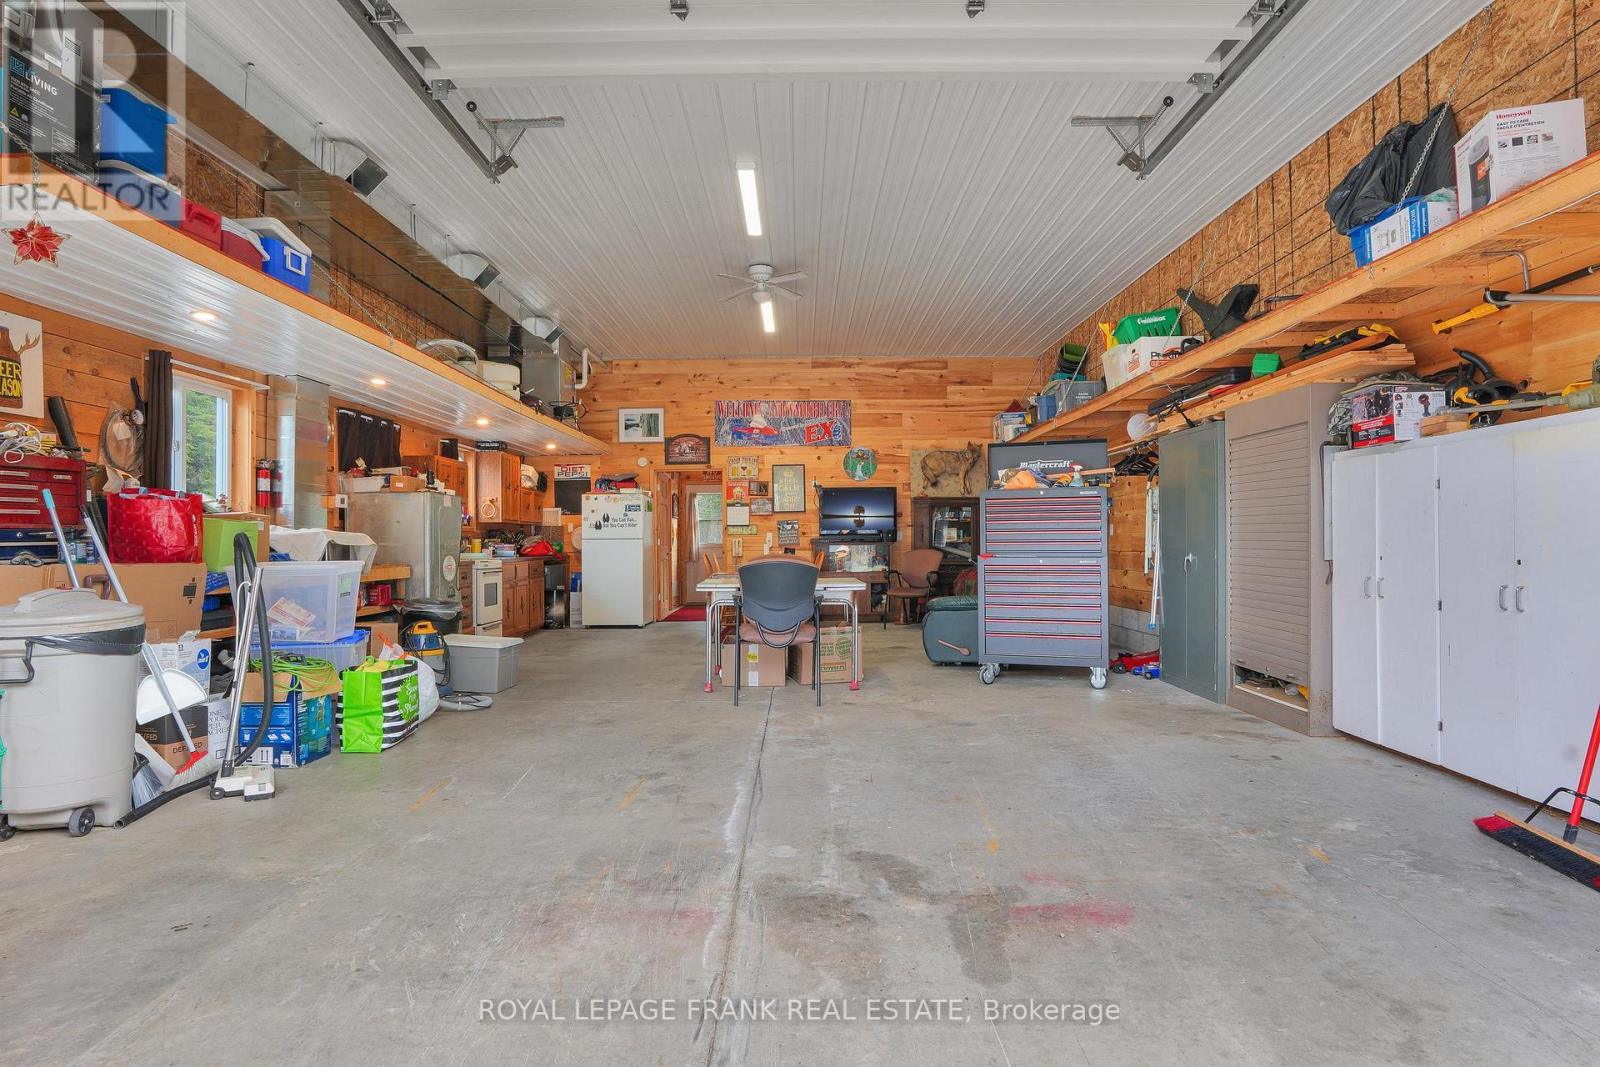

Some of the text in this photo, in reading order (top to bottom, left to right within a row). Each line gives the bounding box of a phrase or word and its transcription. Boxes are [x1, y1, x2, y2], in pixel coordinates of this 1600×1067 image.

[25, 71, 58, 96] LIVING
[1496, 110, 1532, 120] Honeywell
[0, 378, 23, 397] ASON
[1020, 460, 1071, 469] Mastercraft
